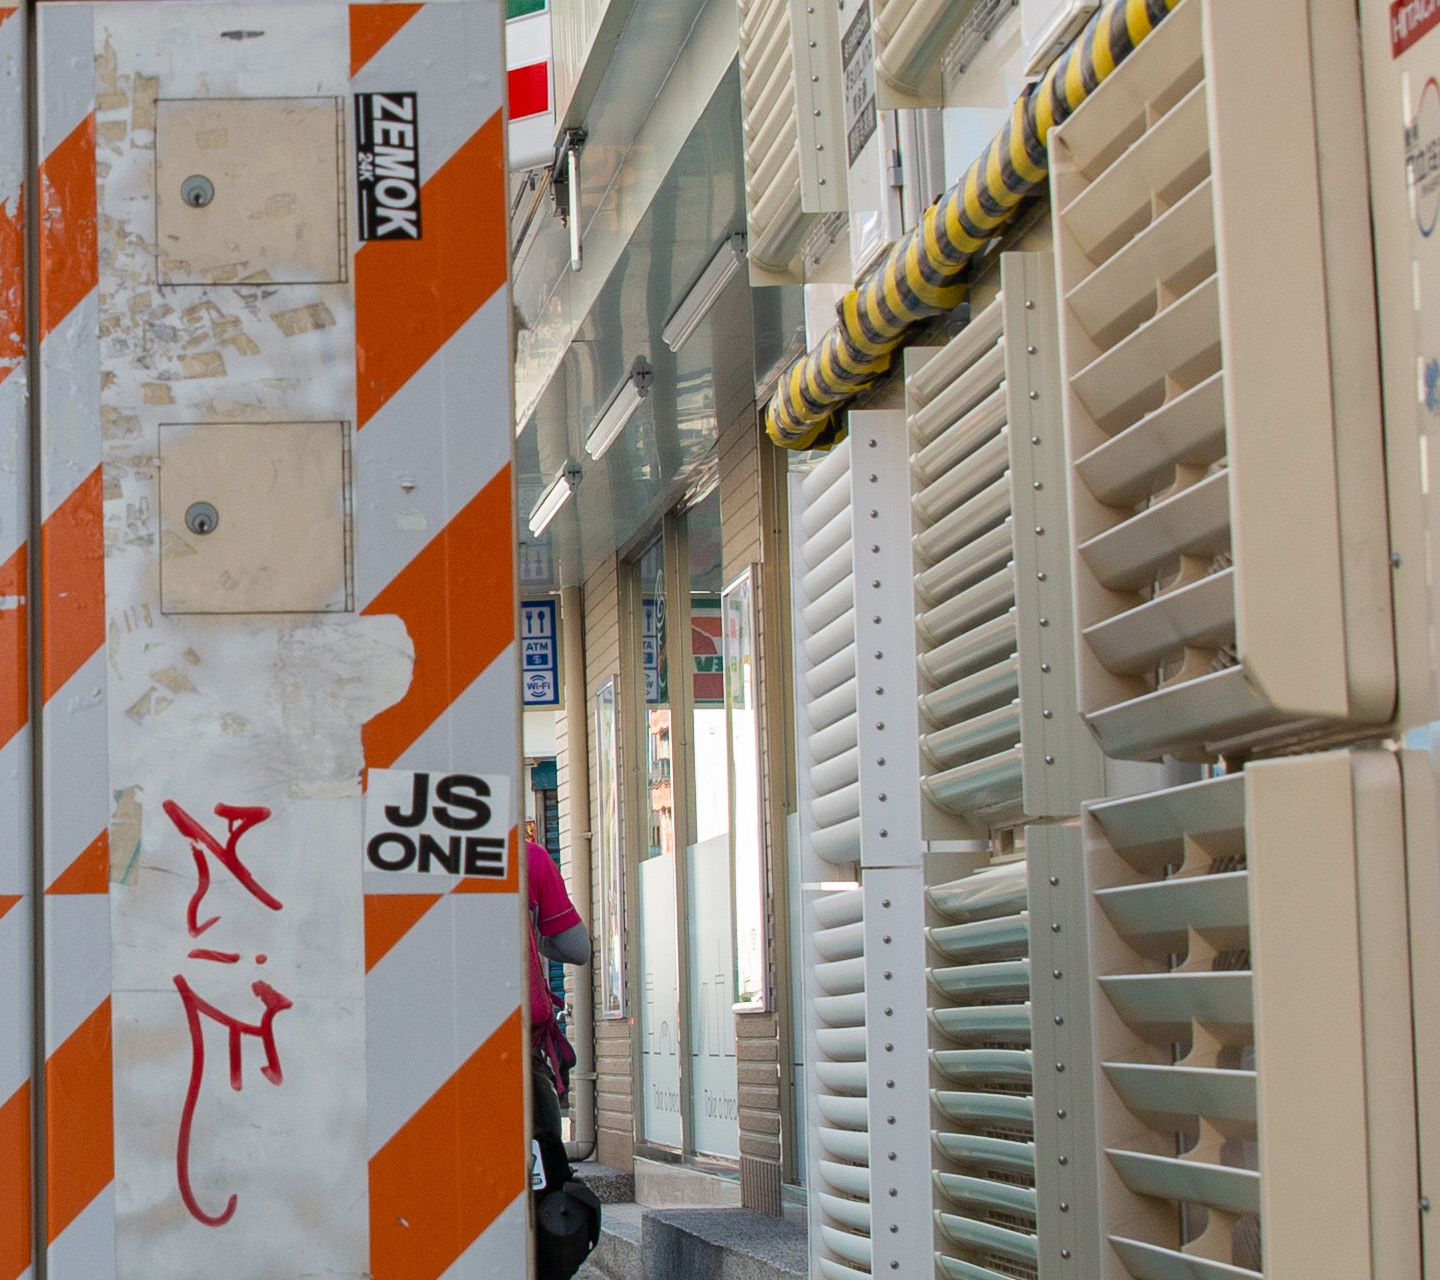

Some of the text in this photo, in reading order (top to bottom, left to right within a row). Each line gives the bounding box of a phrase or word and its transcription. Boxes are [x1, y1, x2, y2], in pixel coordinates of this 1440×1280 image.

[358, 151, 375, 182] 24K
[371, 93, 419, 240] ZEMOK
[525, 641, 549, 652] ATM
[384, 772, 492, 832] JS
[366, 831, 506, 878] ONE
